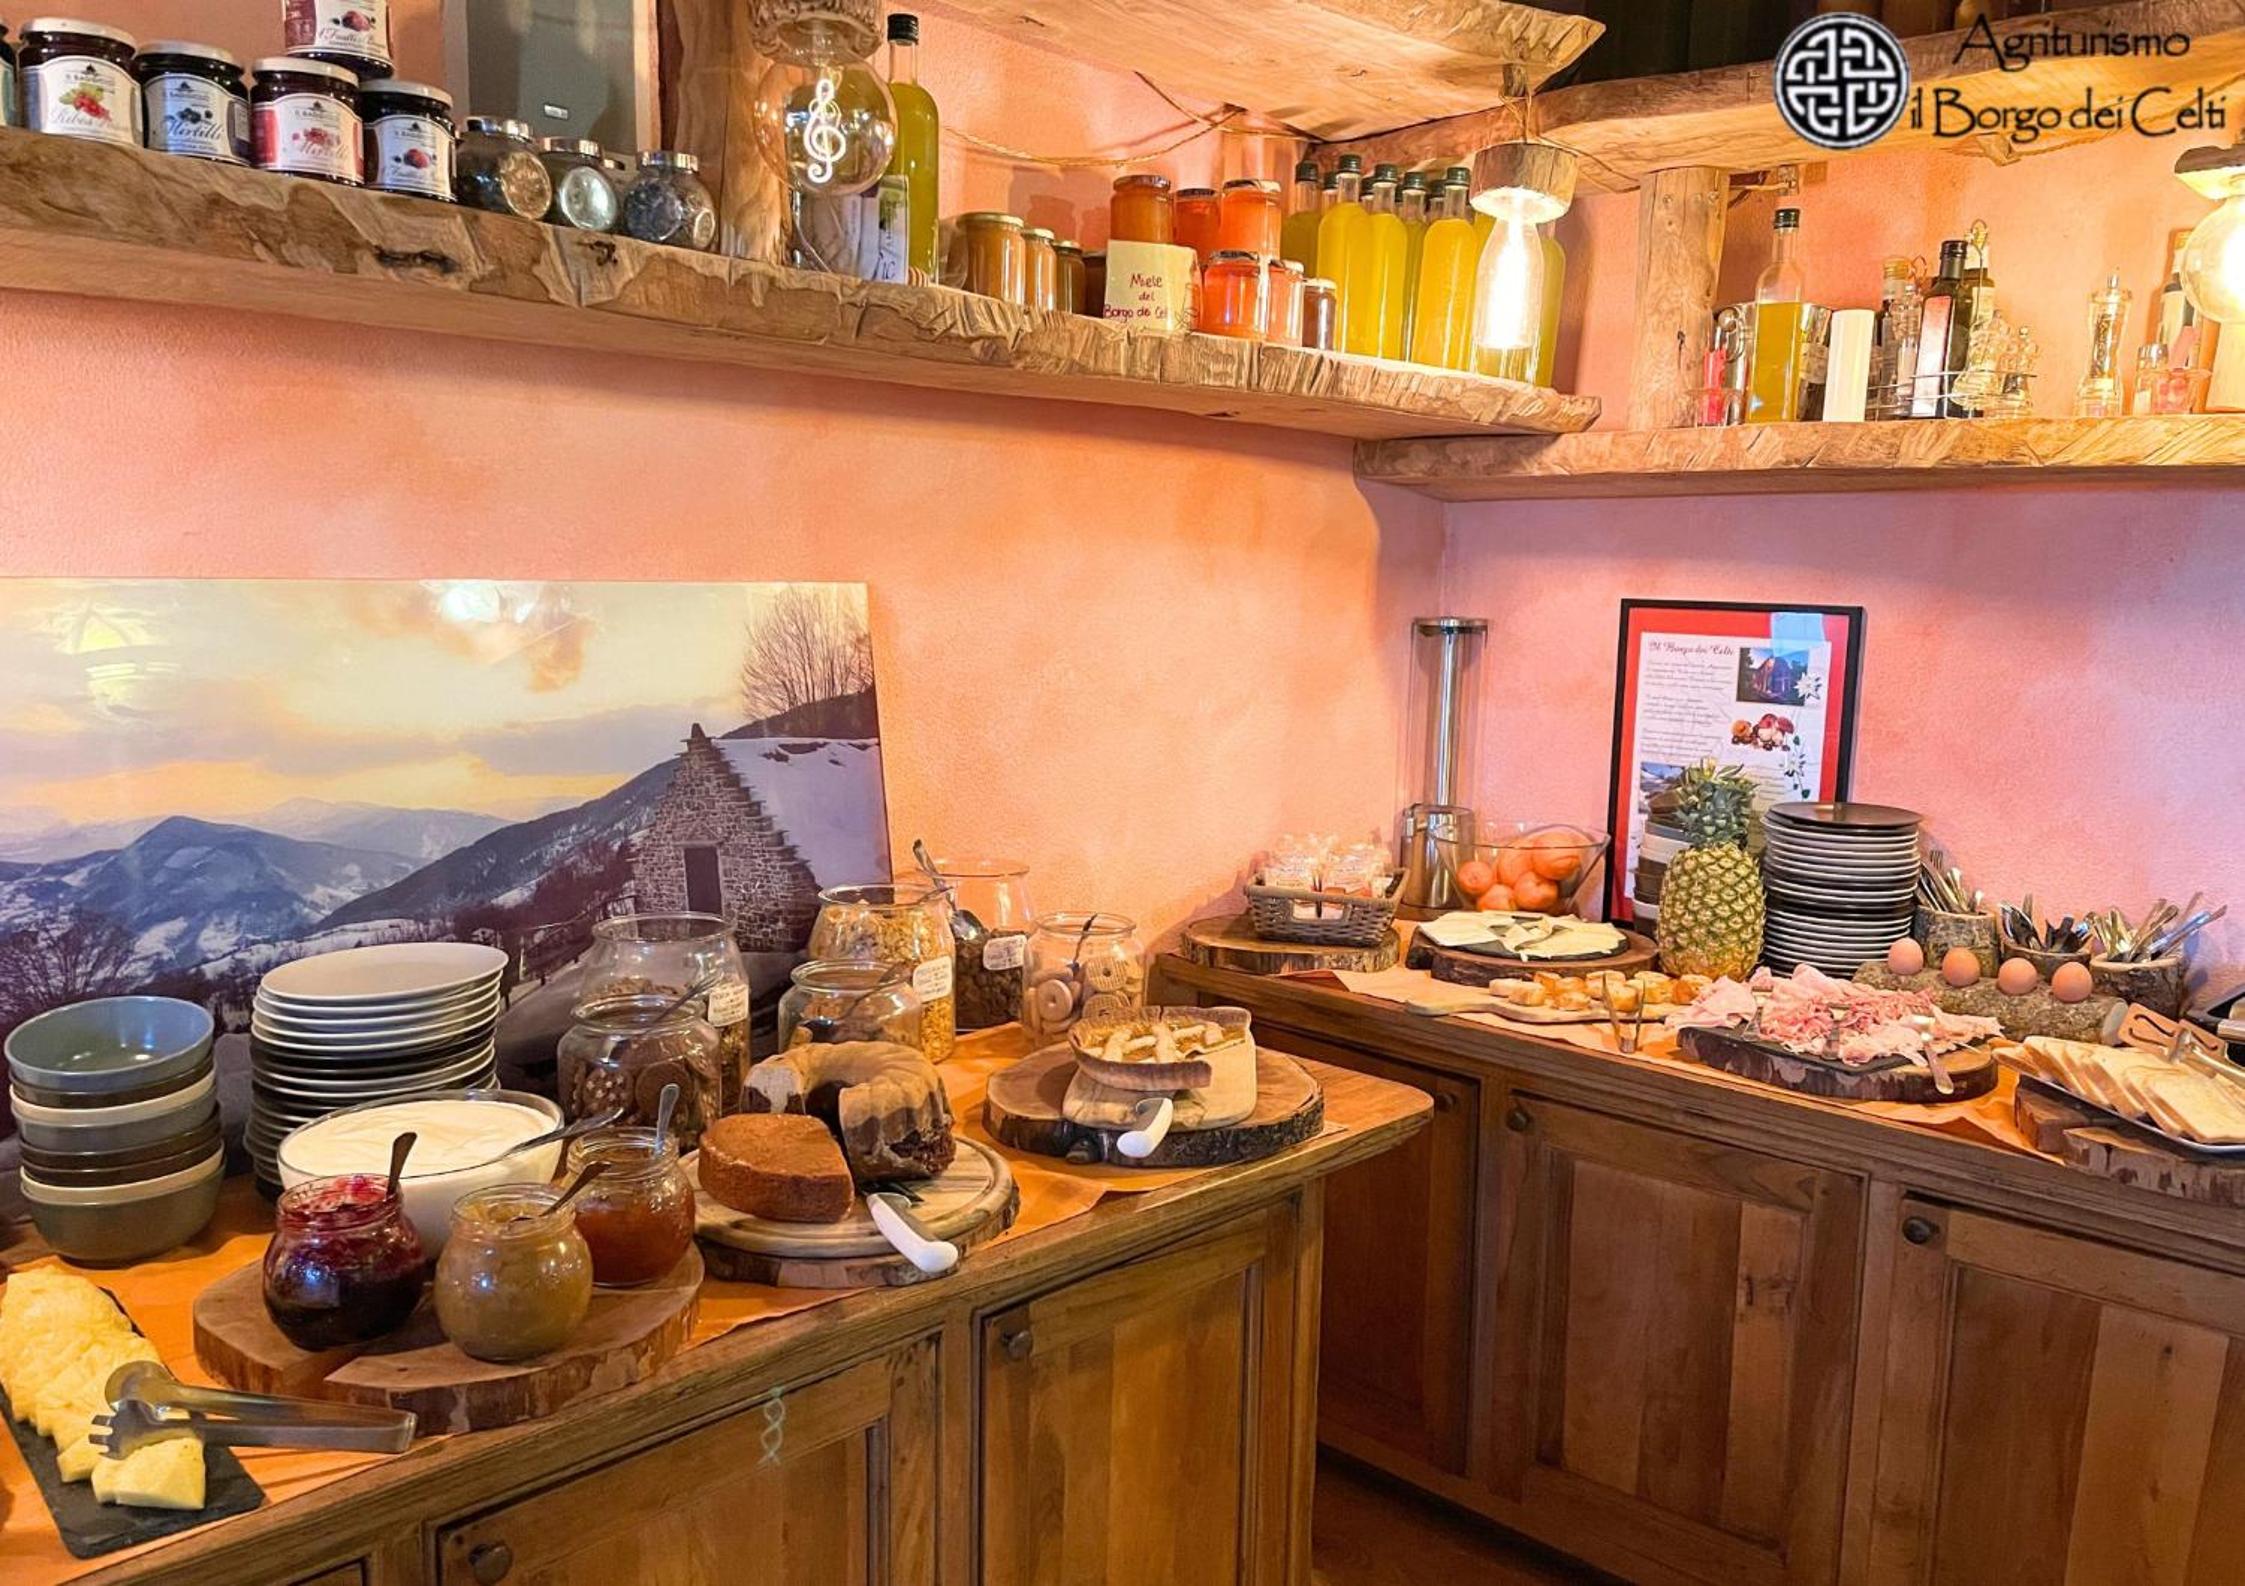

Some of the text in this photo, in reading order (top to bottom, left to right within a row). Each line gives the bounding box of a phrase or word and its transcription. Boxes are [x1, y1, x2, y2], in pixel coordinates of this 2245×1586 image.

[1129, 272, 1163, 288] Miele
[1138, 291, 1155, 301] del
[1103, 304, 1134, 323] Borgo
